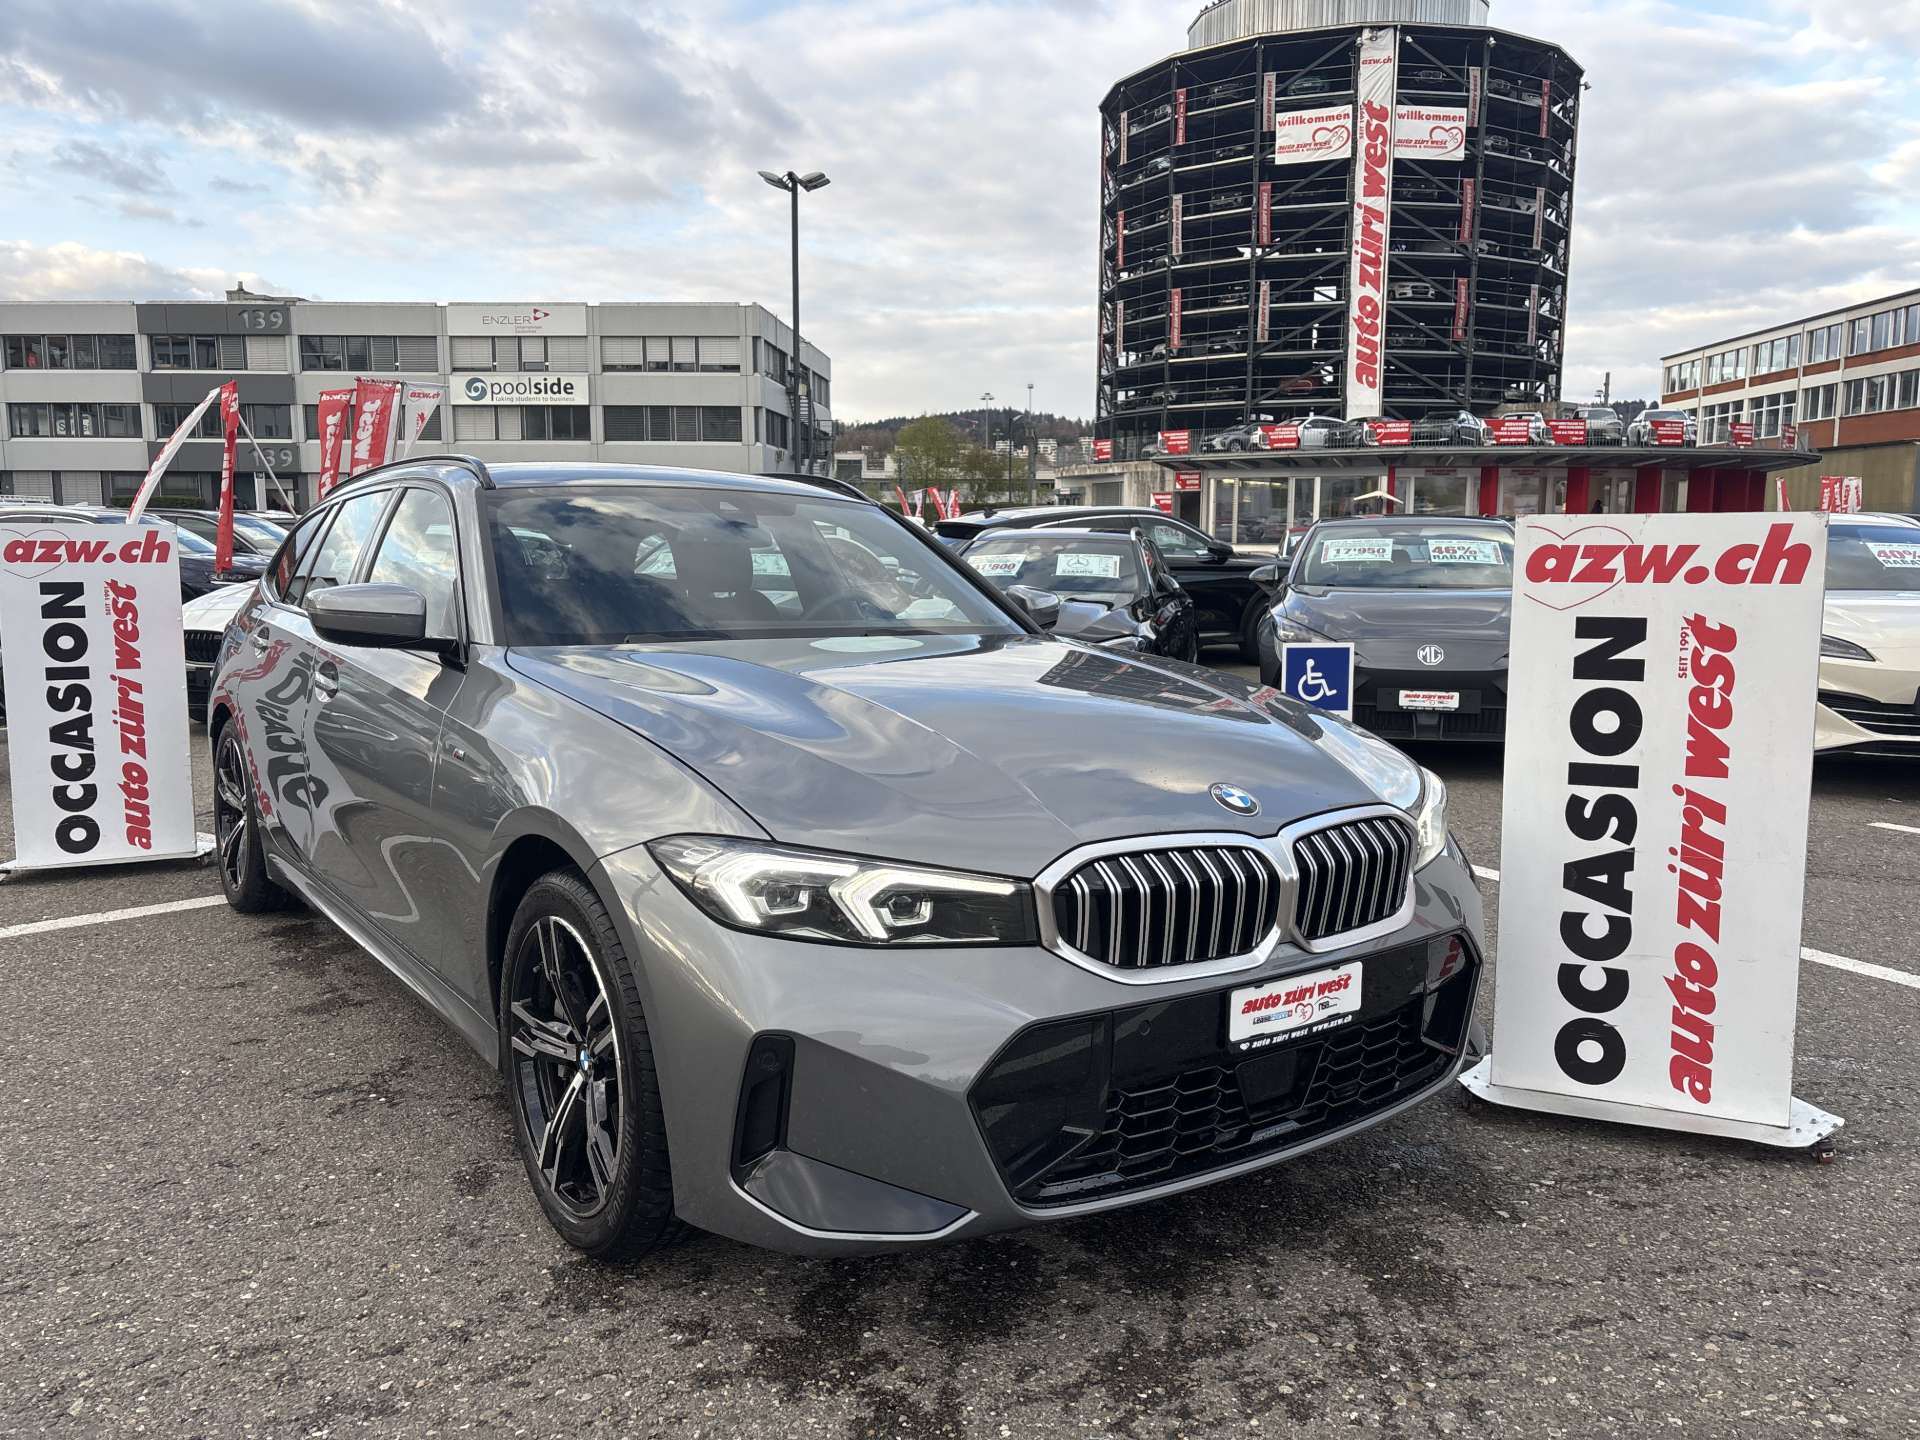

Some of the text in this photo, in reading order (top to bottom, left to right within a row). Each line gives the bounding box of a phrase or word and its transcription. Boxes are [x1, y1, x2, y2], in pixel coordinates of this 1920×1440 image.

[1278, 112, 1350, 128] willkommen
[1397, 111, 1465, 123] willkommen
[1352, 99, 1389, 390] auto züri west
[239, 310, 283, 329] 139
[482, 315, 532, 325] ENZLER
[490, 377, 574, 401] poolside
[3, 530, 171, 564] azw.ch
[1525, 523, 1812, 586] azw.ch
[1419, 646, 1442, 663] MG
[1678, 626, 1690, 679] SEIT 1991
[39, 582, 101, 855] OCCASION
[104, 578, 152, 850] auto züri west
[1554, 616, 1648, 1086] OCCASION
[1663, 613, 1738, 1105] auto züri west
[1241, 993, 1283, 1015] auto
[1282, 982, 1317, 1006] züri
[1317, 973, 1352, 997] west
[1251, 1014, 1353, 1049] auto züri west www.azw.ch
